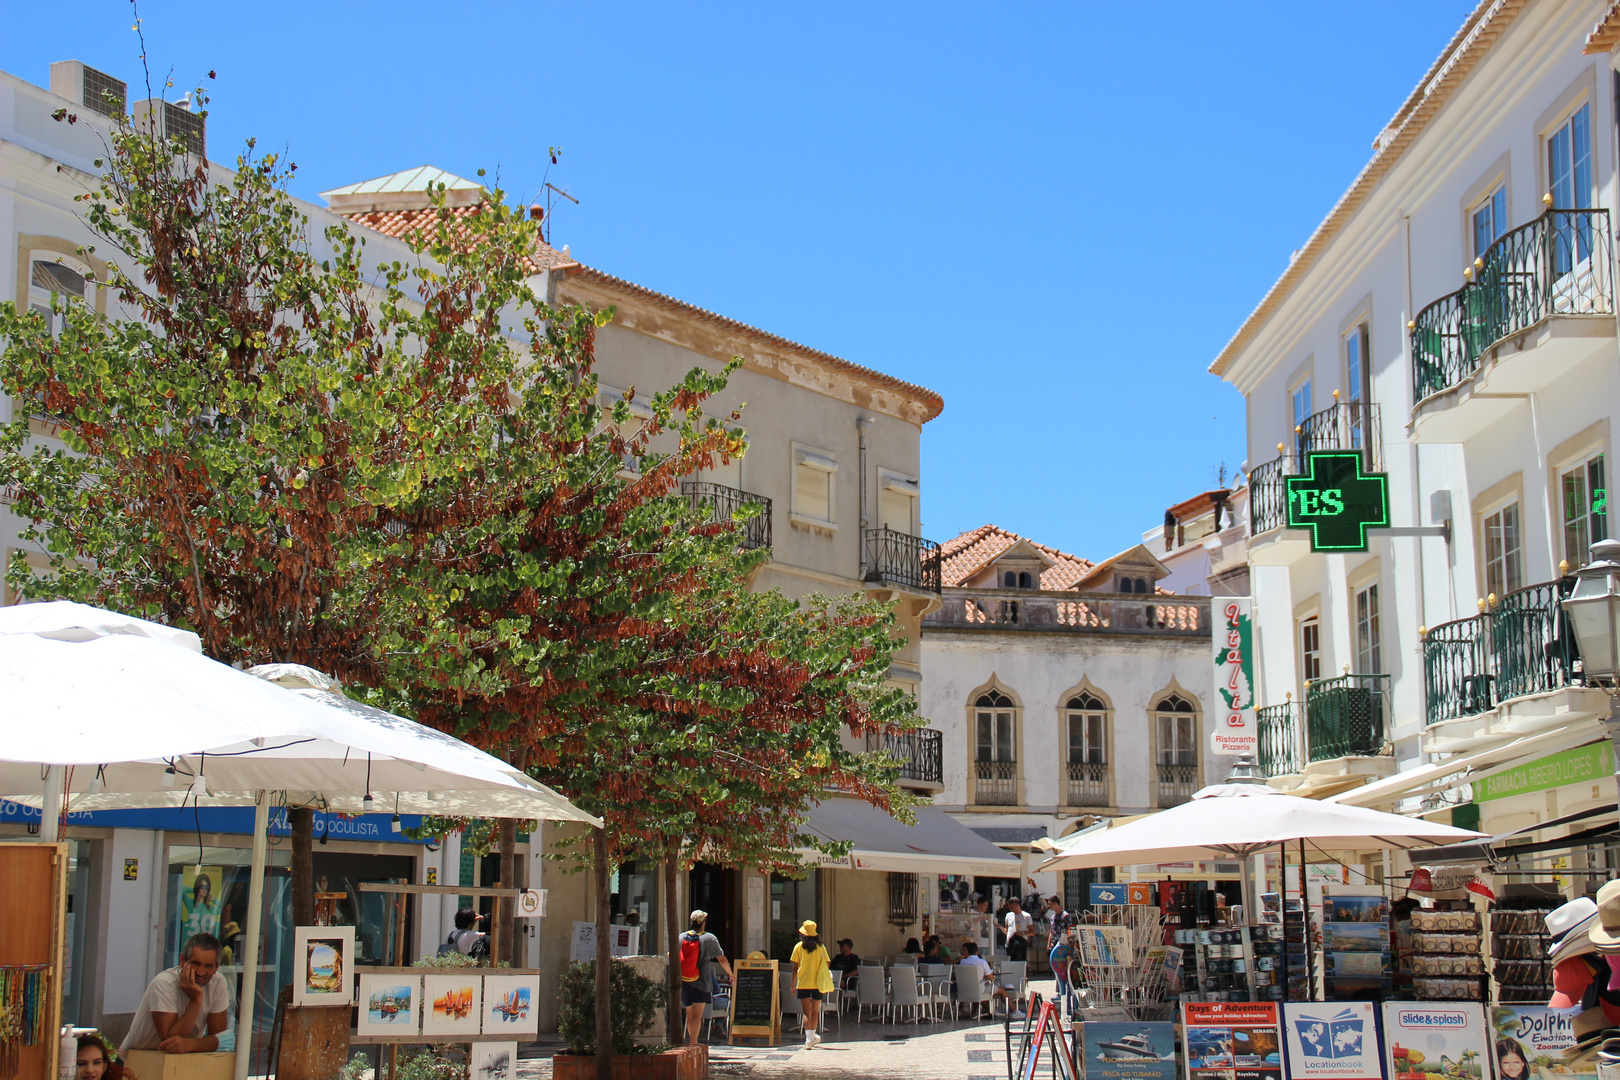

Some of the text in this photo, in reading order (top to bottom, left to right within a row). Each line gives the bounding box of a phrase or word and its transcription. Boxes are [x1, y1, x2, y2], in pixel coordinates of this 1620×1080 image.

[1224, 602, 1245, 727] Italia
[1215, 735, 1256, 743] Ristorante
[1222, 743, 1250, 751] Pizzeria
[1528, 762, 1561, 787] RIBEIRO
[1563, 755, 1592, 780] LOPES
[268, 810, 379, 835] Alto OCULISTA
[822, 856, 849, 865] CAVALEIRO
[1188, 1004, 1273, 1013] Days of Adventure
[1516, 1012, 1573, 1039] Dolphi
